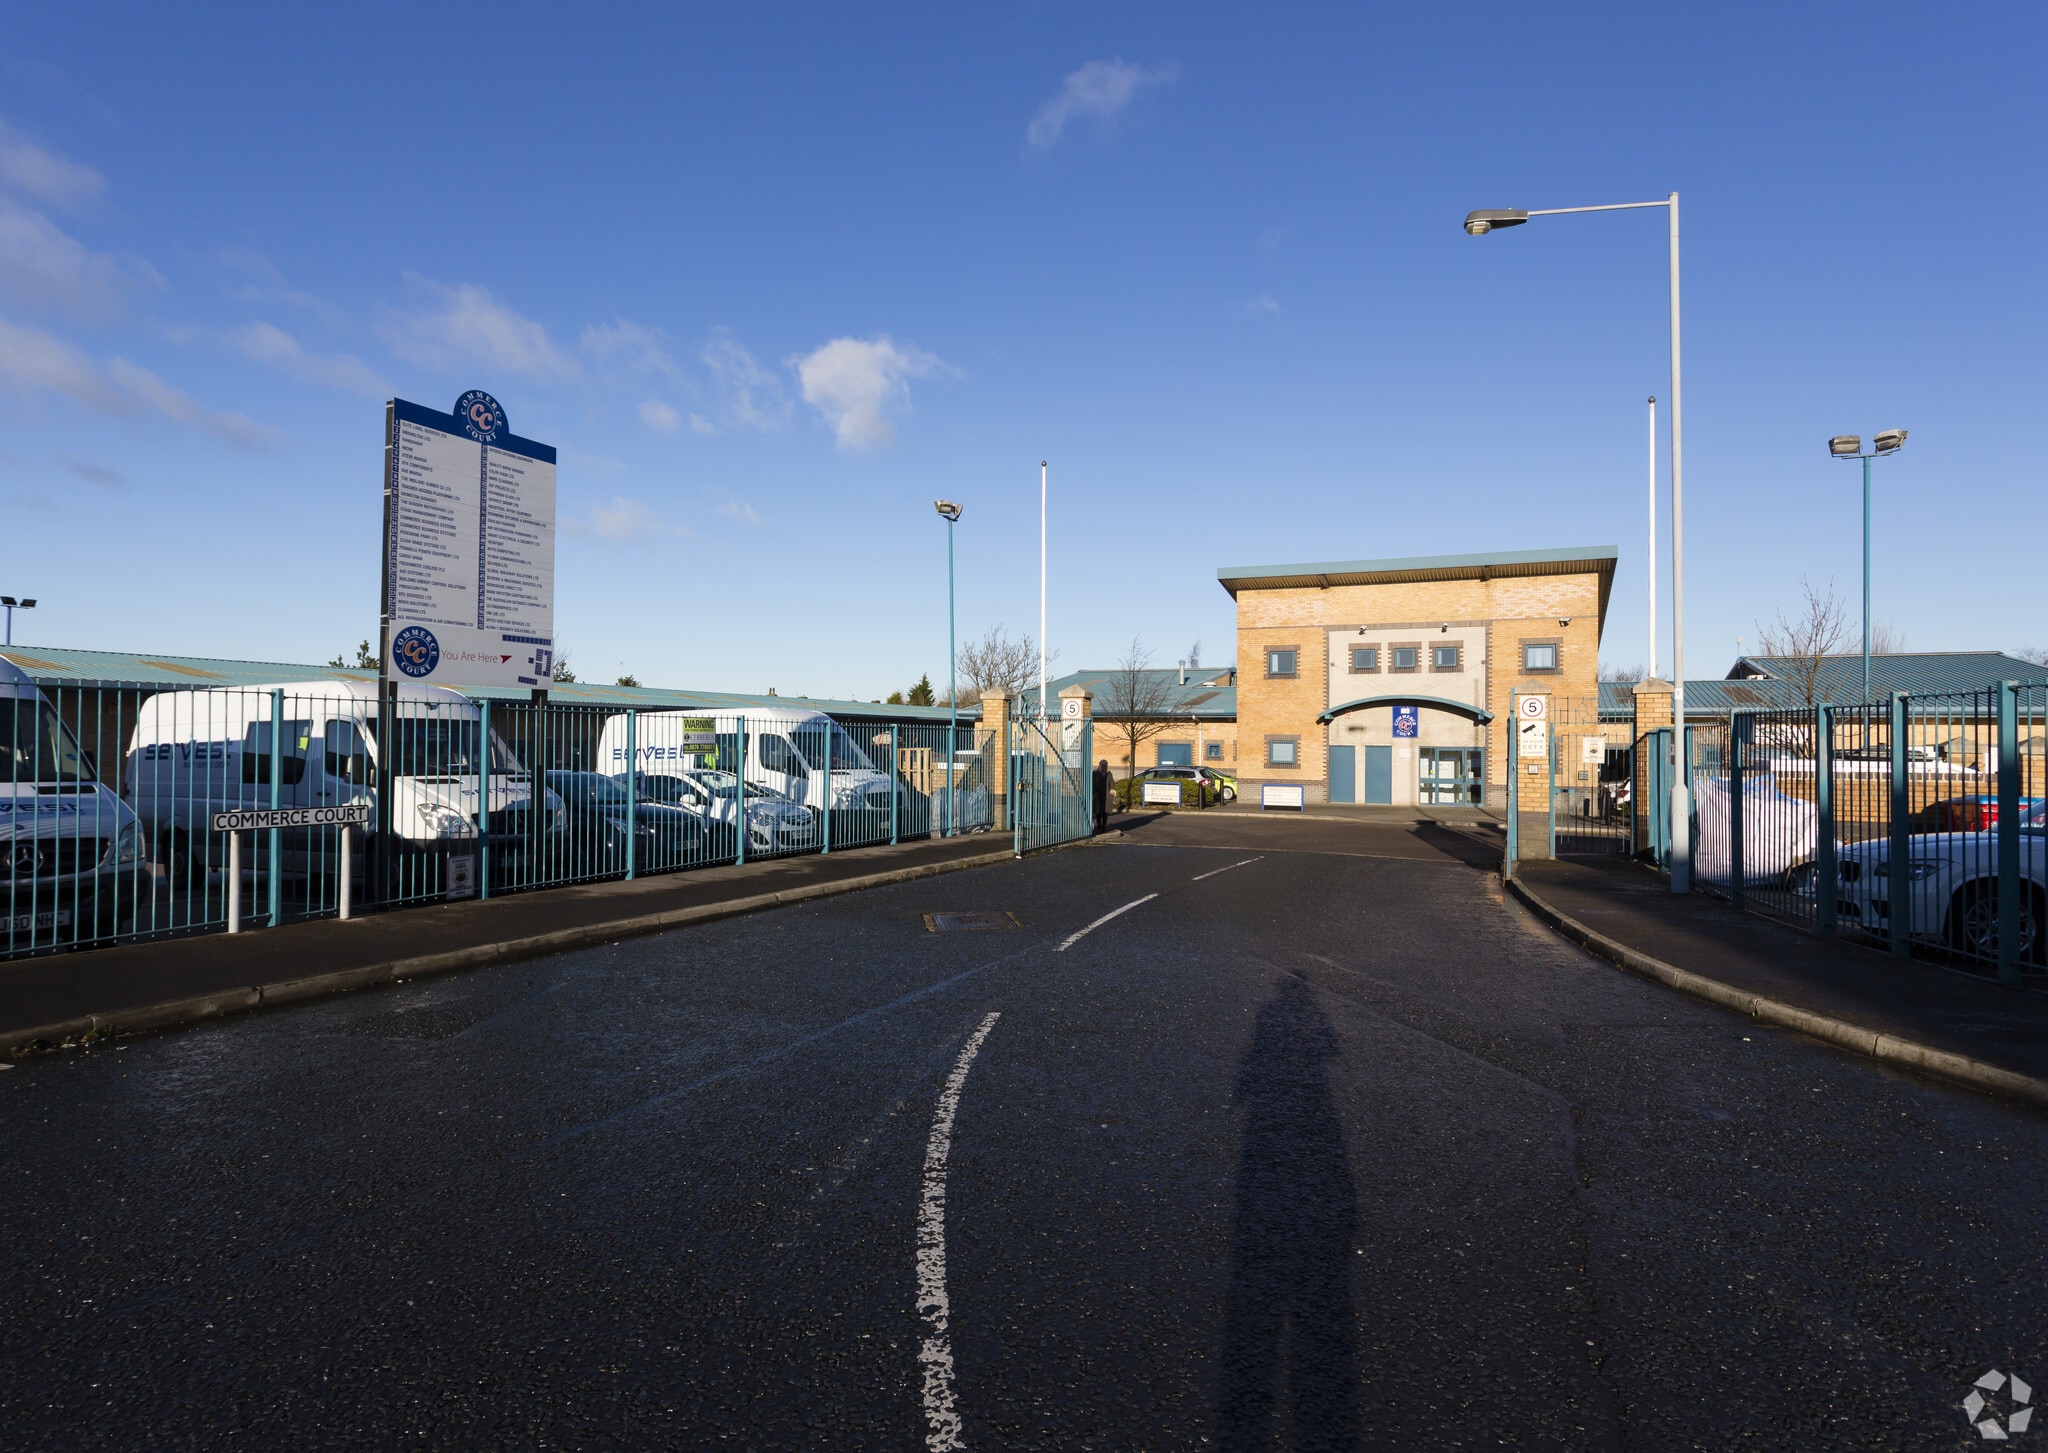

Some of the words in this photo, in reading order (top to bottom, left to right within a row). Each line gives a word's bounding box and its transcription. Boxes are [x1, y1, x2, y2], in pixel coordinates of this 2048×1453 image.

[461, 391, 502, 427] COMMERCE
[466, 424, 496, 442] COURT
[395, 629, 438, 656] COMMERCE
[441, 650, 458, 661] You
[460, 652, 476, 662] Are
[478, 652, 498, 664] Here
[401, 661, 431, 675] COURT
[1070, 705, 1076, 713] 5
[1529, 702, 1536, 712] 5
[684, 720, 714, 728] WARNING
[1394, 715, 1416, 726] COMMERCE
[216, 810, 309, 829] COMMERCE
[315, 807, 366, 822] COURT
